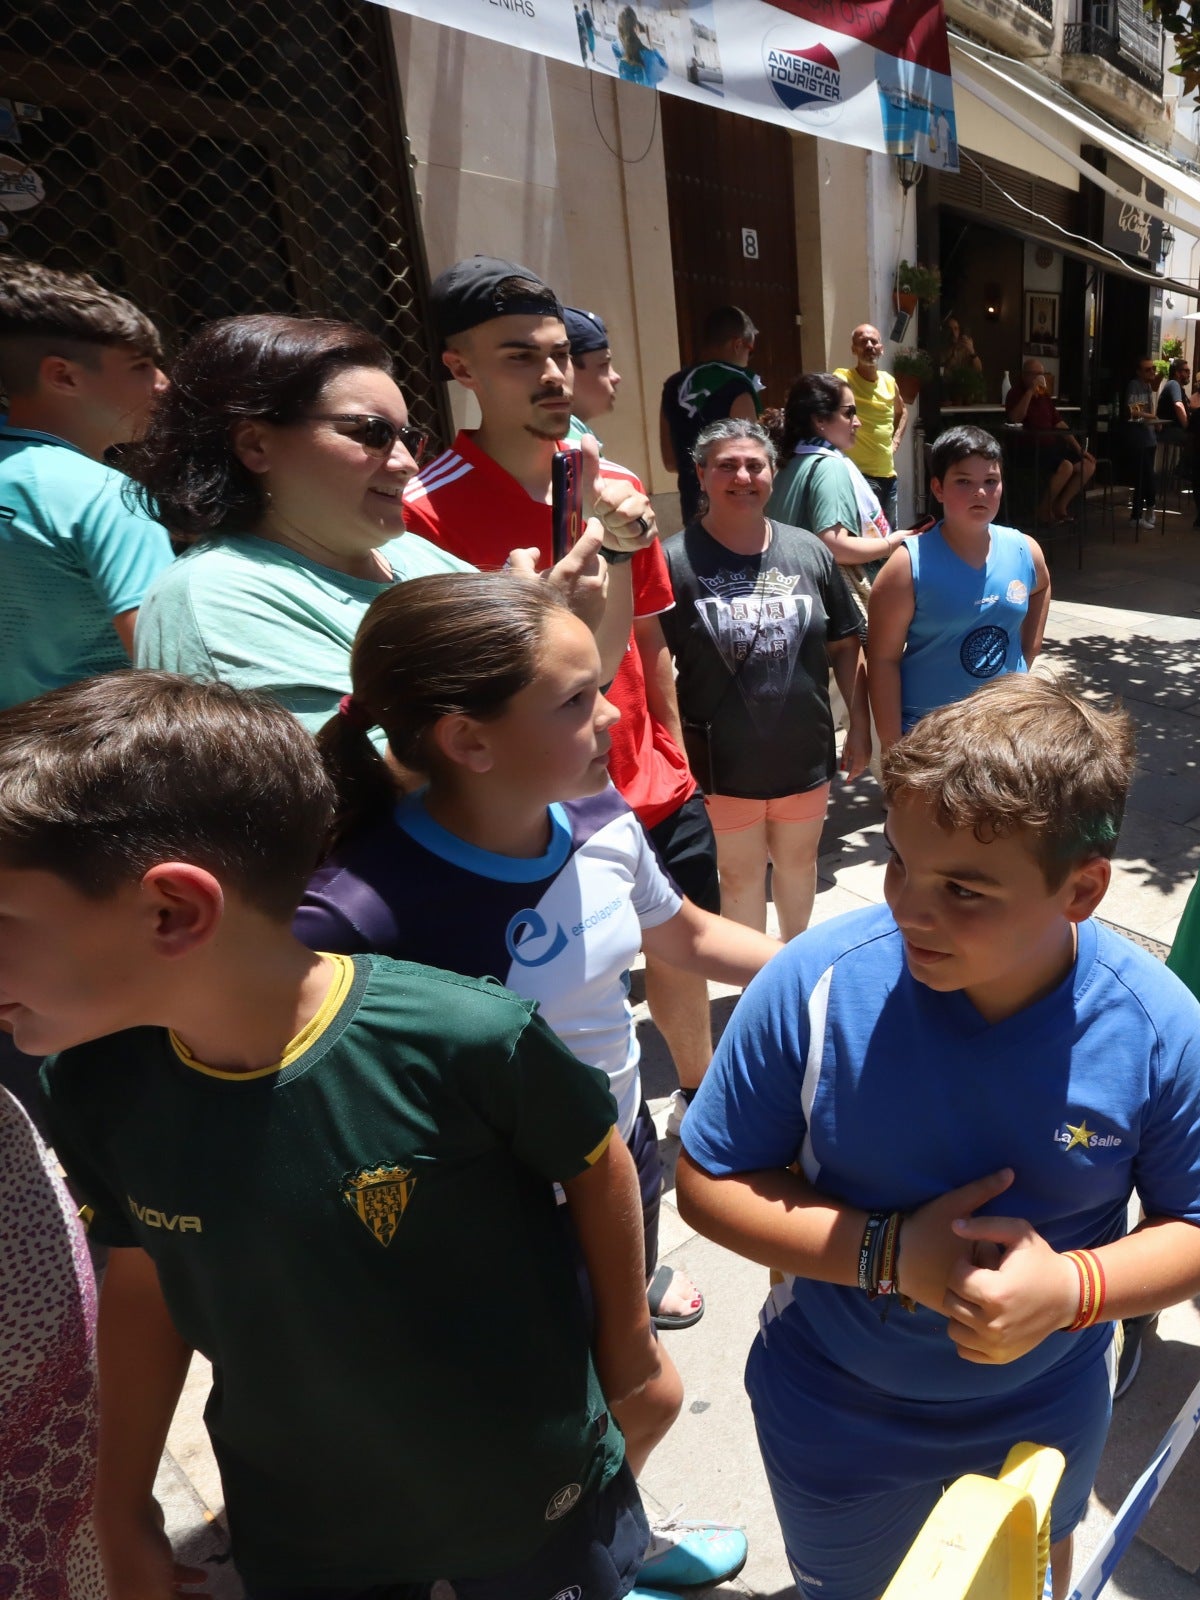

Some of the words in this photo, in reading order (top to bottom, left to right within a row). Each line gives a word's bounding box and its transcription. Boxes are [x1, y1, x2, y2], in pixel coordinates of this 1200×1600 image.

[767, 50, 841, 87] AMERICAN
[768, 63, 841, 100] TOURISTER
[745, 234, 757, 257] 8
[571, 896, 623, 937] escolapias
[1053, 1128, 1072, 1144] La
[1089, 1134, 1122, 1147] Salle
[127, 1194, 203, 1234] VOVA
